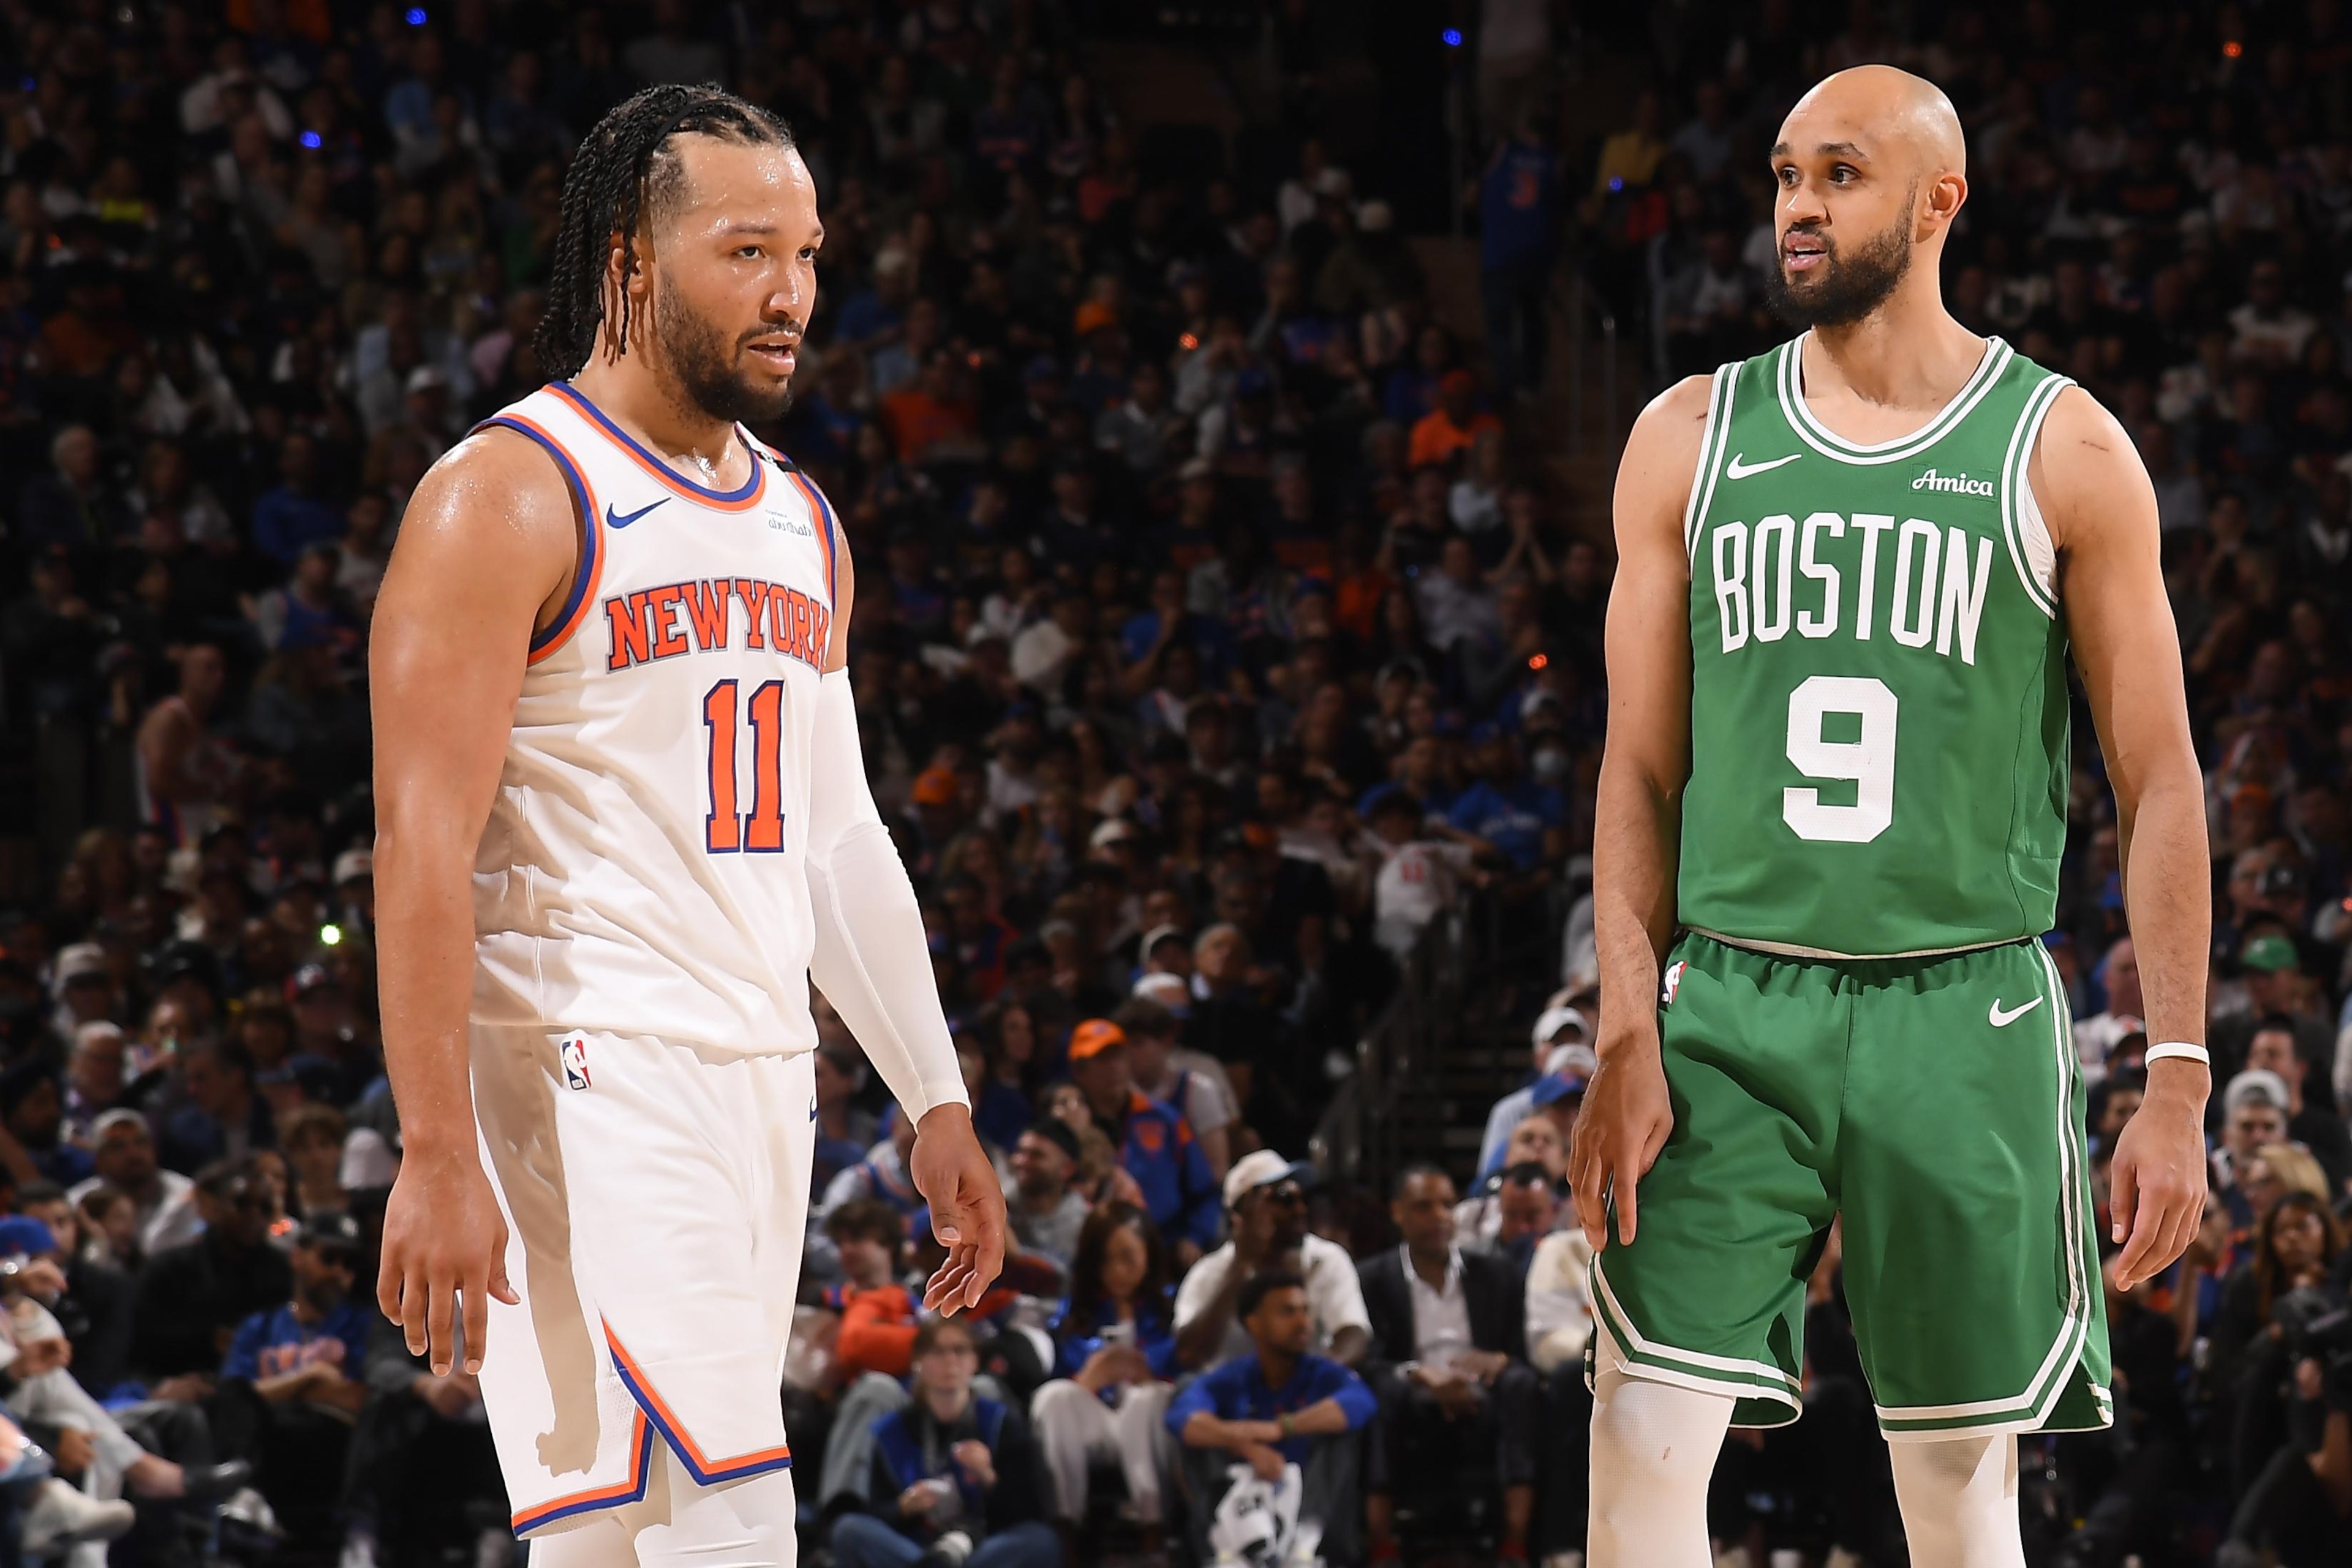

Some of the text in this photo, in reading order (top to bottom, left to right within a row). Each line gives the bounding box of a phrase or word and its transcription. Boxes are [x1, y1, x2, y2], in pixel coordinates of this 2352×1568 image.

[1912, 469, 1994, 497] Amica
[601, 577, 829, 681] NEW YORK
[1713, 512, 1994, 666] BOSTON
[703, 679, 785, 854] 11
[1782, 676, 1898, 843] 9
